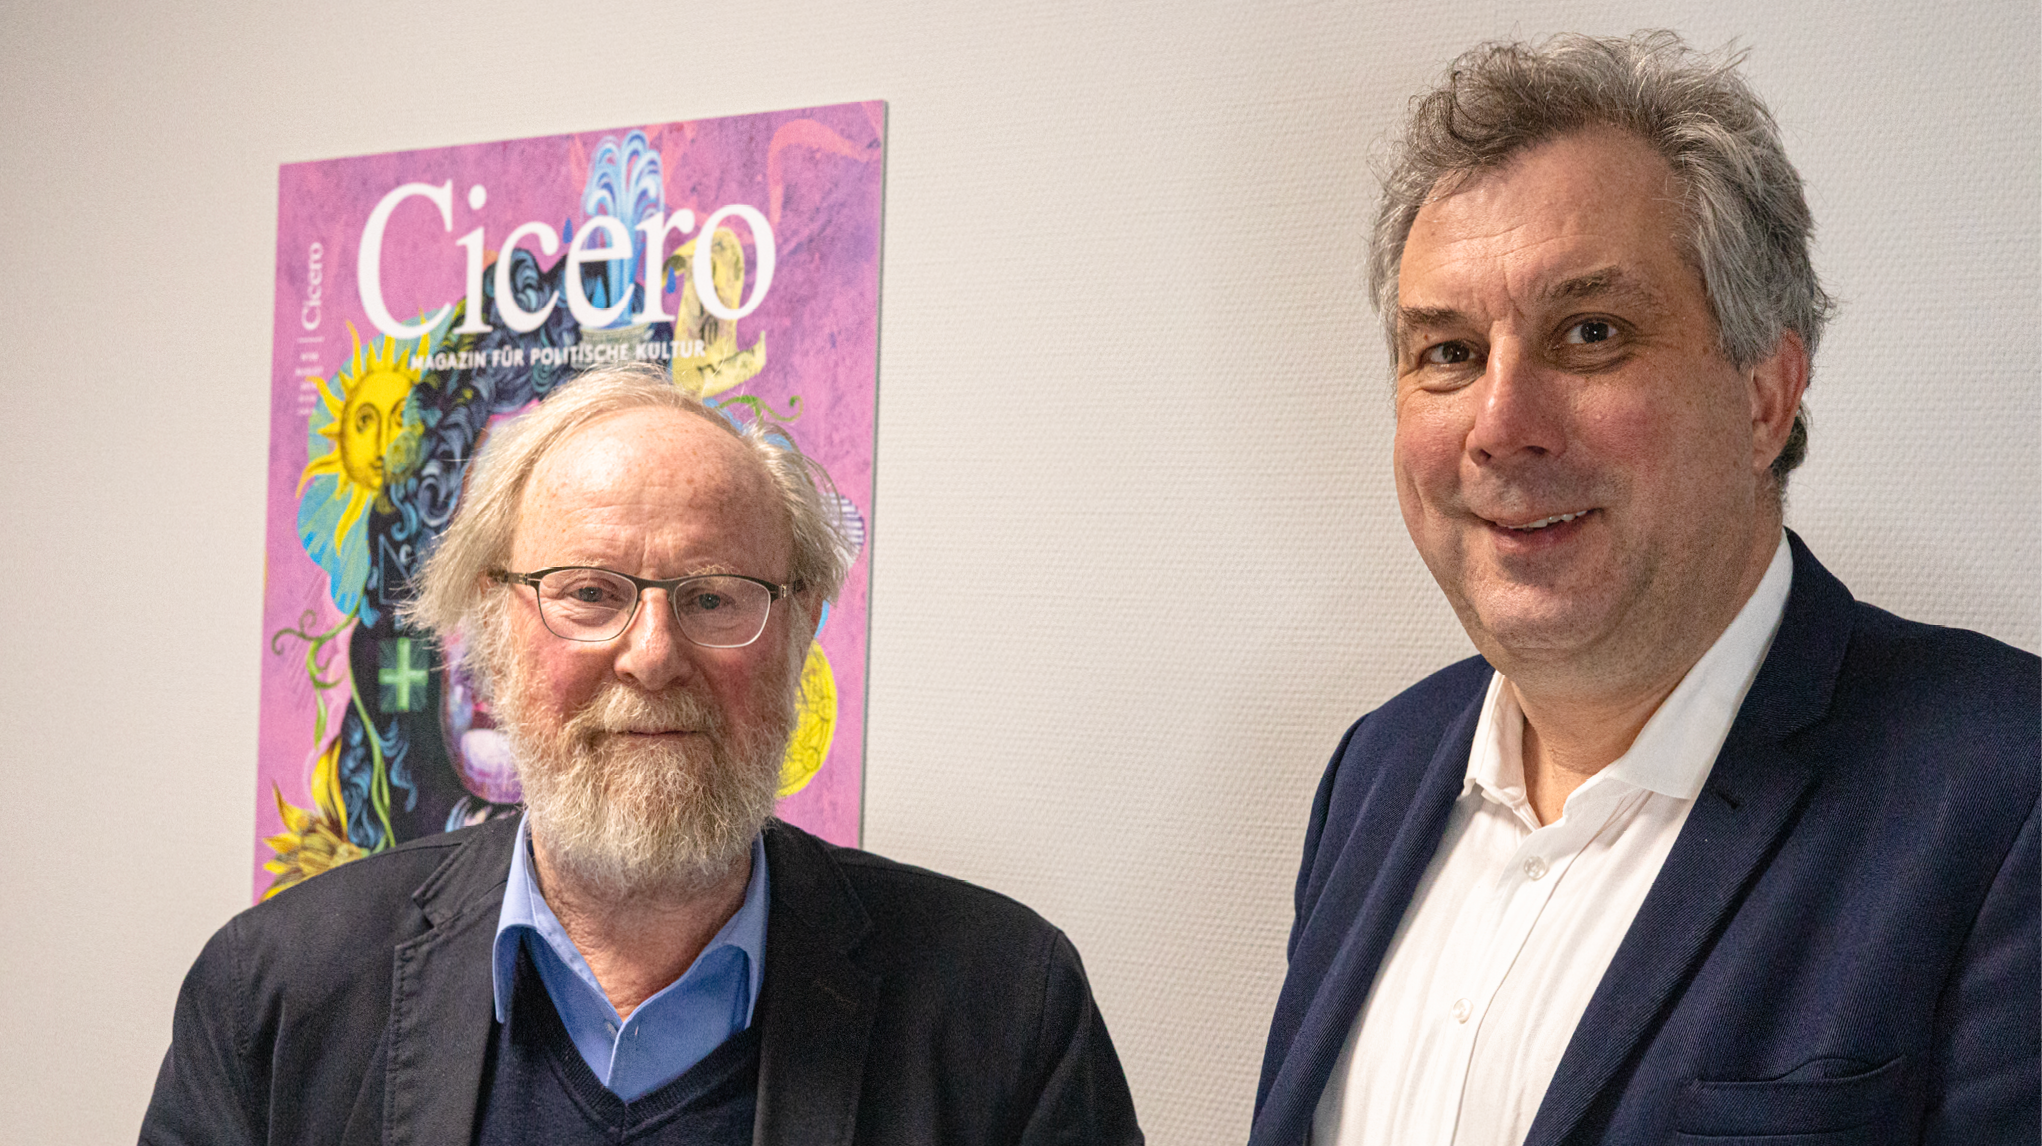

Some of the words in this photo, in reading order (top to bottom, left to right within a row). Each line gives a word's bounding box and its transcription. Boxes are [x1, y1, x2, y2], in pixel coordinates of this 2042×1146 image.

[301, 242, 323, 330] Cicero
[357, 178, 776, 340] Cicero
[410, 350, 487, 371] MAGAZIN
[491, 345, 525, 368] FÜR
[530, 342, 630, 366] POLITISCHE
[635, 339, 706, 360] KULTUR
